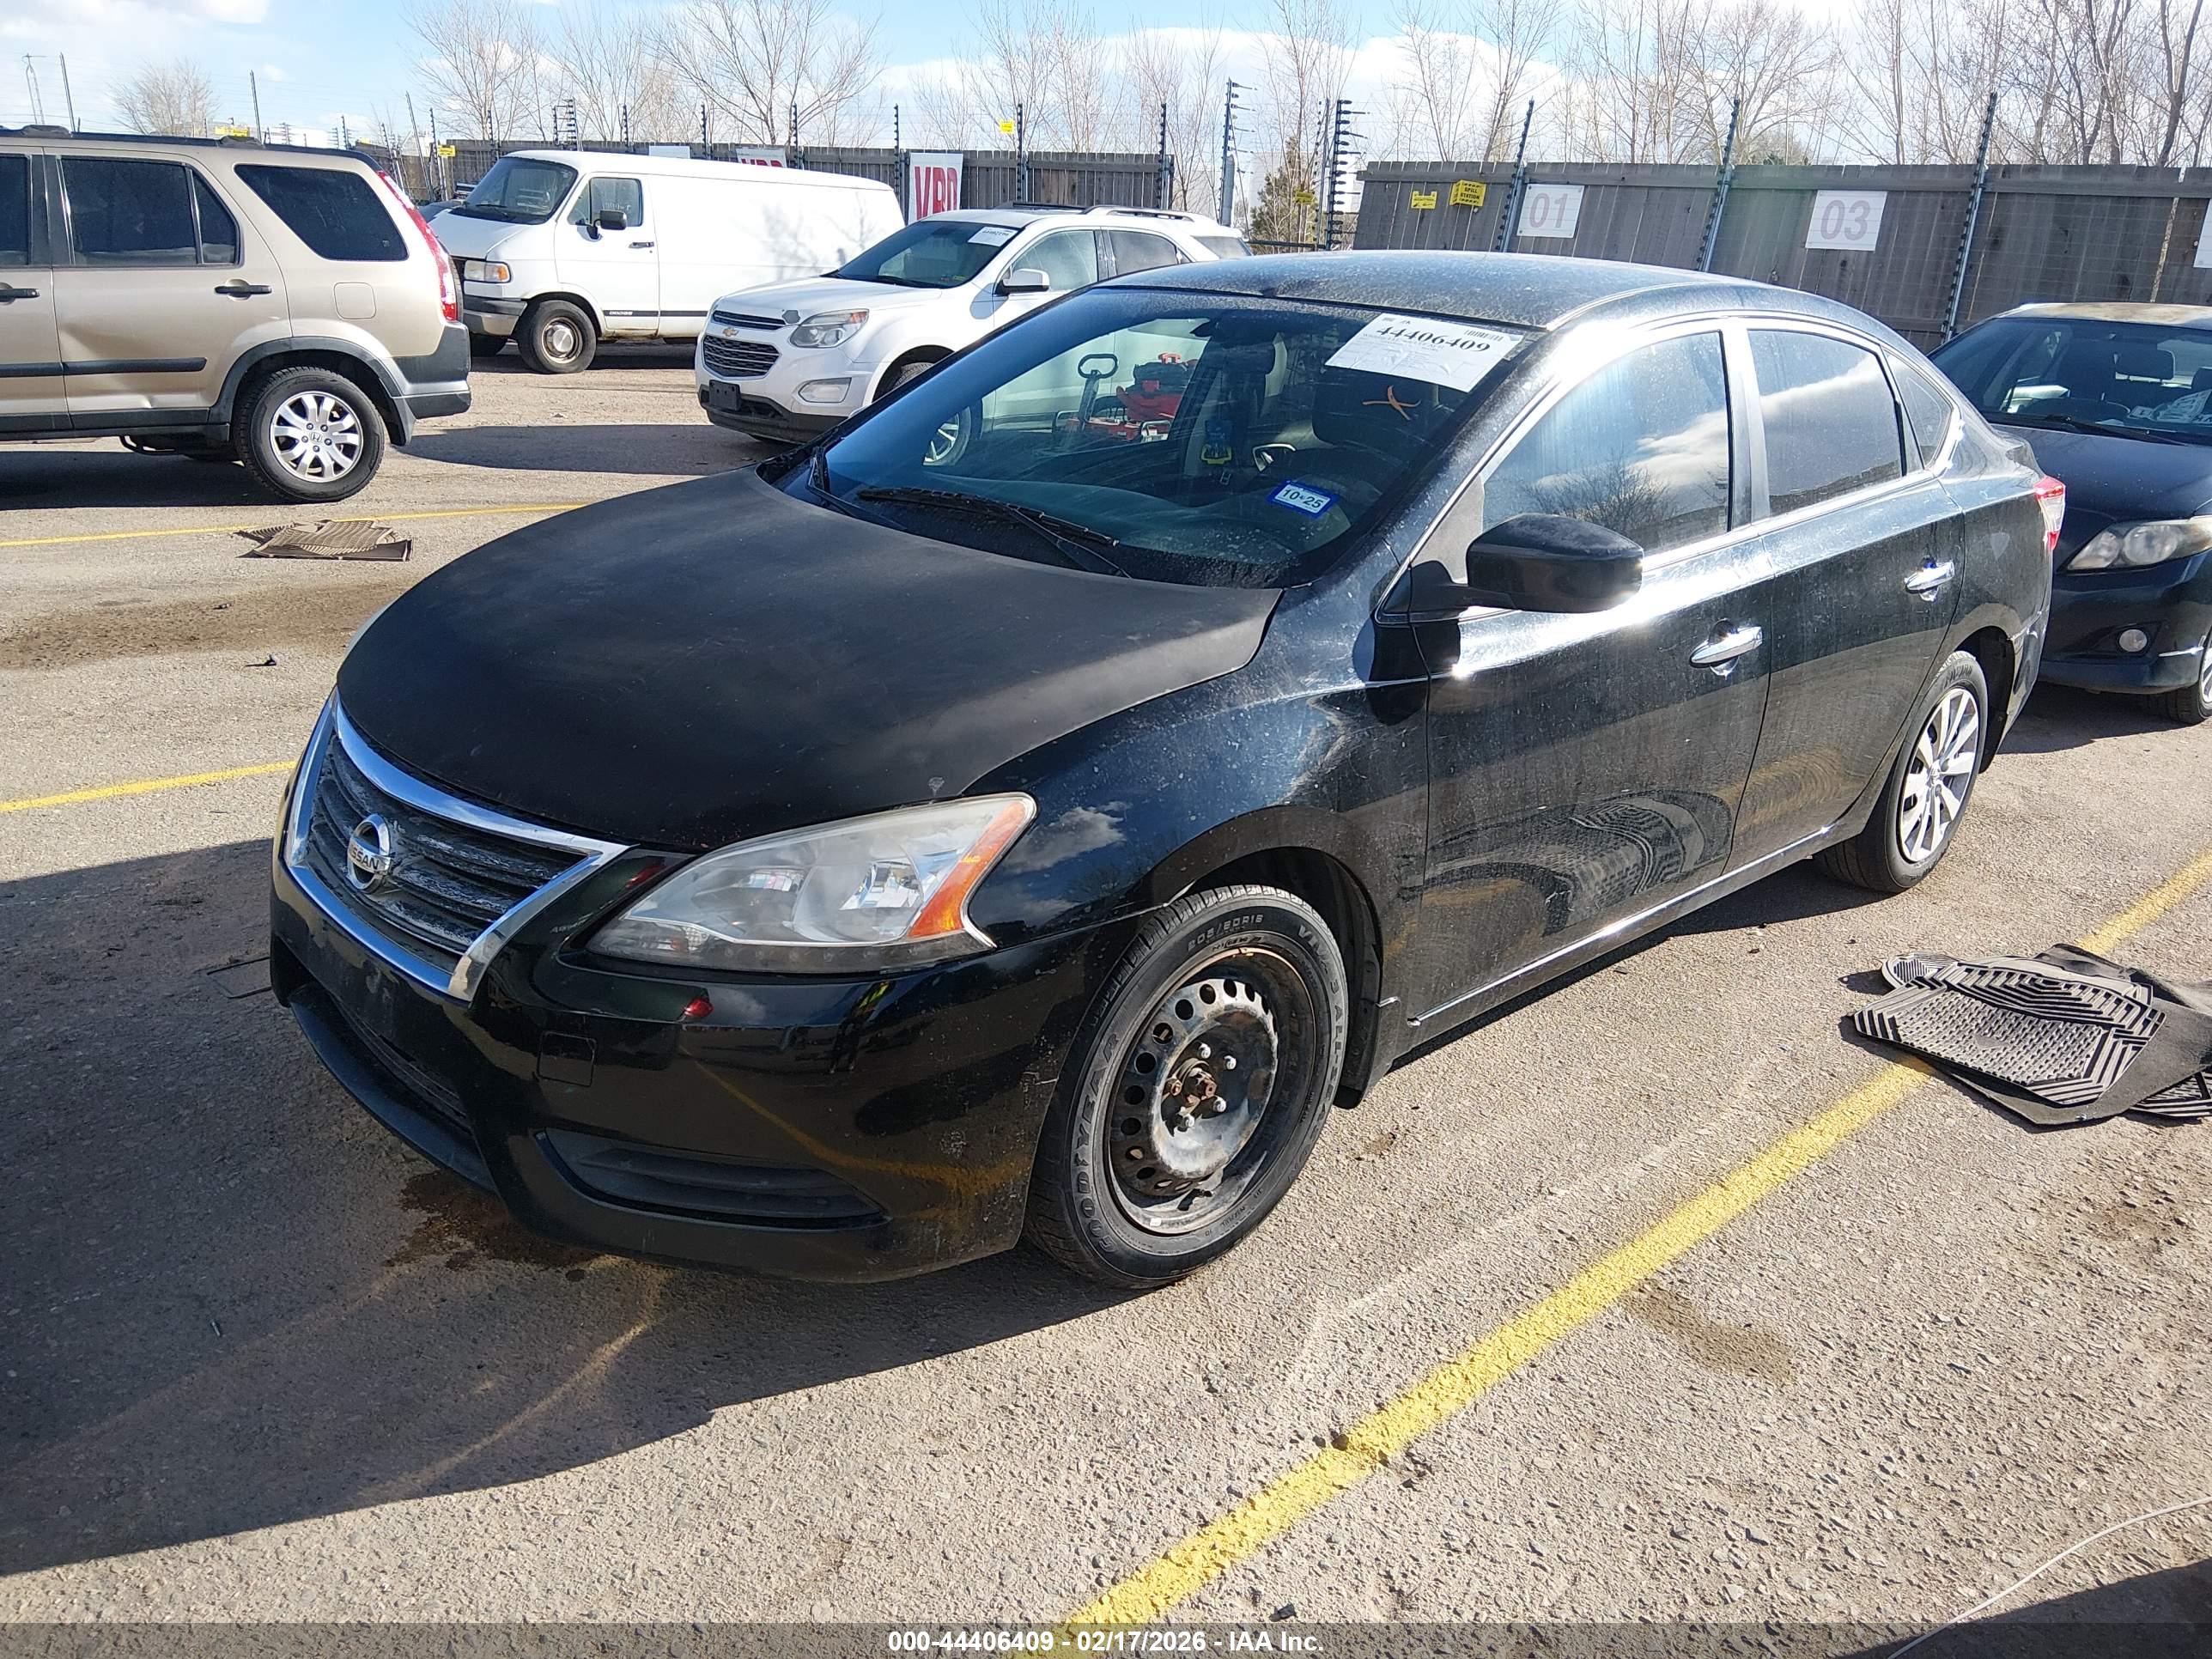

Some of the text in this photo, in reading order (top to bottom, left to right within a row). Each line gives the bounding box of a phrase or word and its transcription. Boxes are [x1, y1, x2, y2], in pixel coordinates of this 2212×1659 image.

[1529, 192, 1568, 228] 01
[1820, 199, 1870, 240] 03
[1376, 326, 1491, 352] 44406409
[349, 845, 379, 870] SSAN
[1074, 1032, 1119, 1254] GOODYEAR
